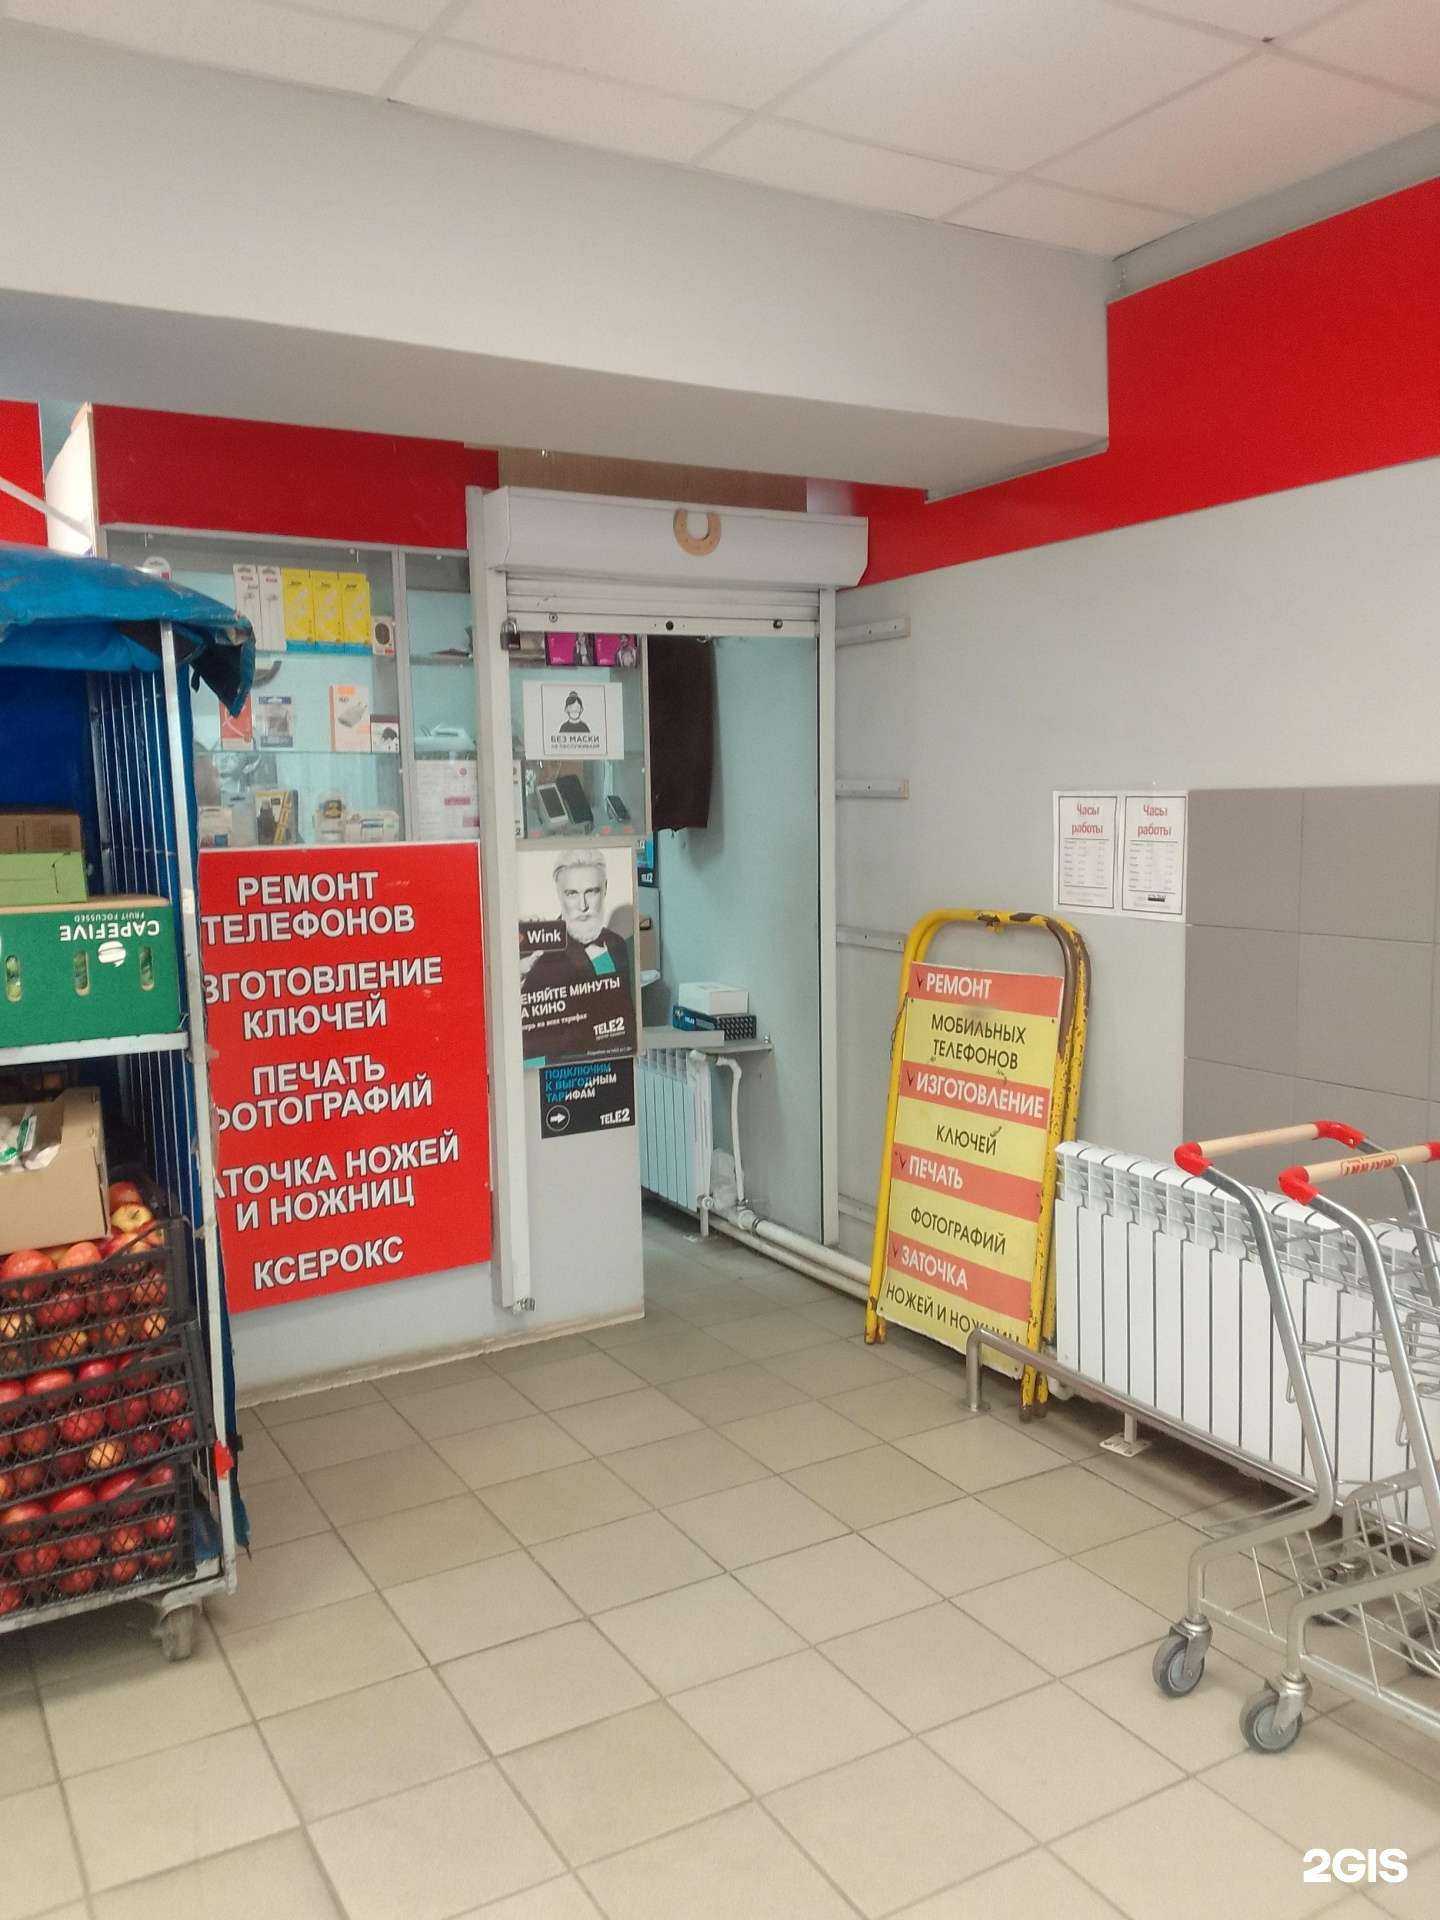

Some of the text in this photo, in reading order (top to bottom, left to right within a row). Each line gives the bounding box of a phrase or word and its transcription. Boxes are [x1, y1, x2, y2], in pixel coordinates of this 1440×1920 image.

[551, 735, 599, 743] БЕЗ МАСКИ
[1076, 803, 1100, 816] Часы
[1143, 804, 1168, 817] Часы
[1071, 821, 1103, 836] работы
[1137, 823, 1172, 837] работы
[237, 871, 379, 907] РЕМОНТ
[121, 911, 145, 920] FRUIT
[201, 904, 416, 946] ТЕЛЕФОНОВ
[59, 920, 160, 941] CAPEFIVE
[527, 928, 561, 943] Wink
[203, 956, 443, 1005] ЗГОТОВЛЕНИЕ
[520, 977, 621, 1005] ЕНЯЙТЕ МИНУТЫ
[925, 972, 993, 1000] РЕМОНТ
[243, 993, 388, 1040] КЛЮЧЕЙ
[532, 1000, 566, 1017] КИНО
[593, 1016, 625, 1036] TELE2
[931, 1013, 1027, 1045] МОБИЛЬНЫХ
[933, 1039, 1018, 1070] ТЕЛЕФОНОВ
[252, 1055, 386, 1096] ПЕЧАТЬ
[544, 1062, 611, 1081] ПОДКЛЮЧИМ
[555, 1073, 617, 1090] ВЫГОДНЫМ
[546, 1087, 596, 1103] ТАРИФАМ
[916, 1071, 1044, 1120] ИЗГОТОВЛЕНИЕ
[600, 1107, 631, 1126] TELE2
[346, 1129, 460, 1178] НОЖЕЙ
[936, 1124, 998, 1156] КЛЮЧЕЙ
[908, 1155, 964, 1190] ПЕЧАТЬ
[235, 1175, 416, 1232] И НОЖНИЦ
[911, 1206, 1007, 1255] ФОТОГРАФИЙ
[254, 1236, 405, 1290] КСЕРОКС
[901, 1245, 969, 1291] ЗАТОЧКА
[886, 1282, 934, 1318] НОЖЕЙ
[937, 1303, 947, 1322] И
